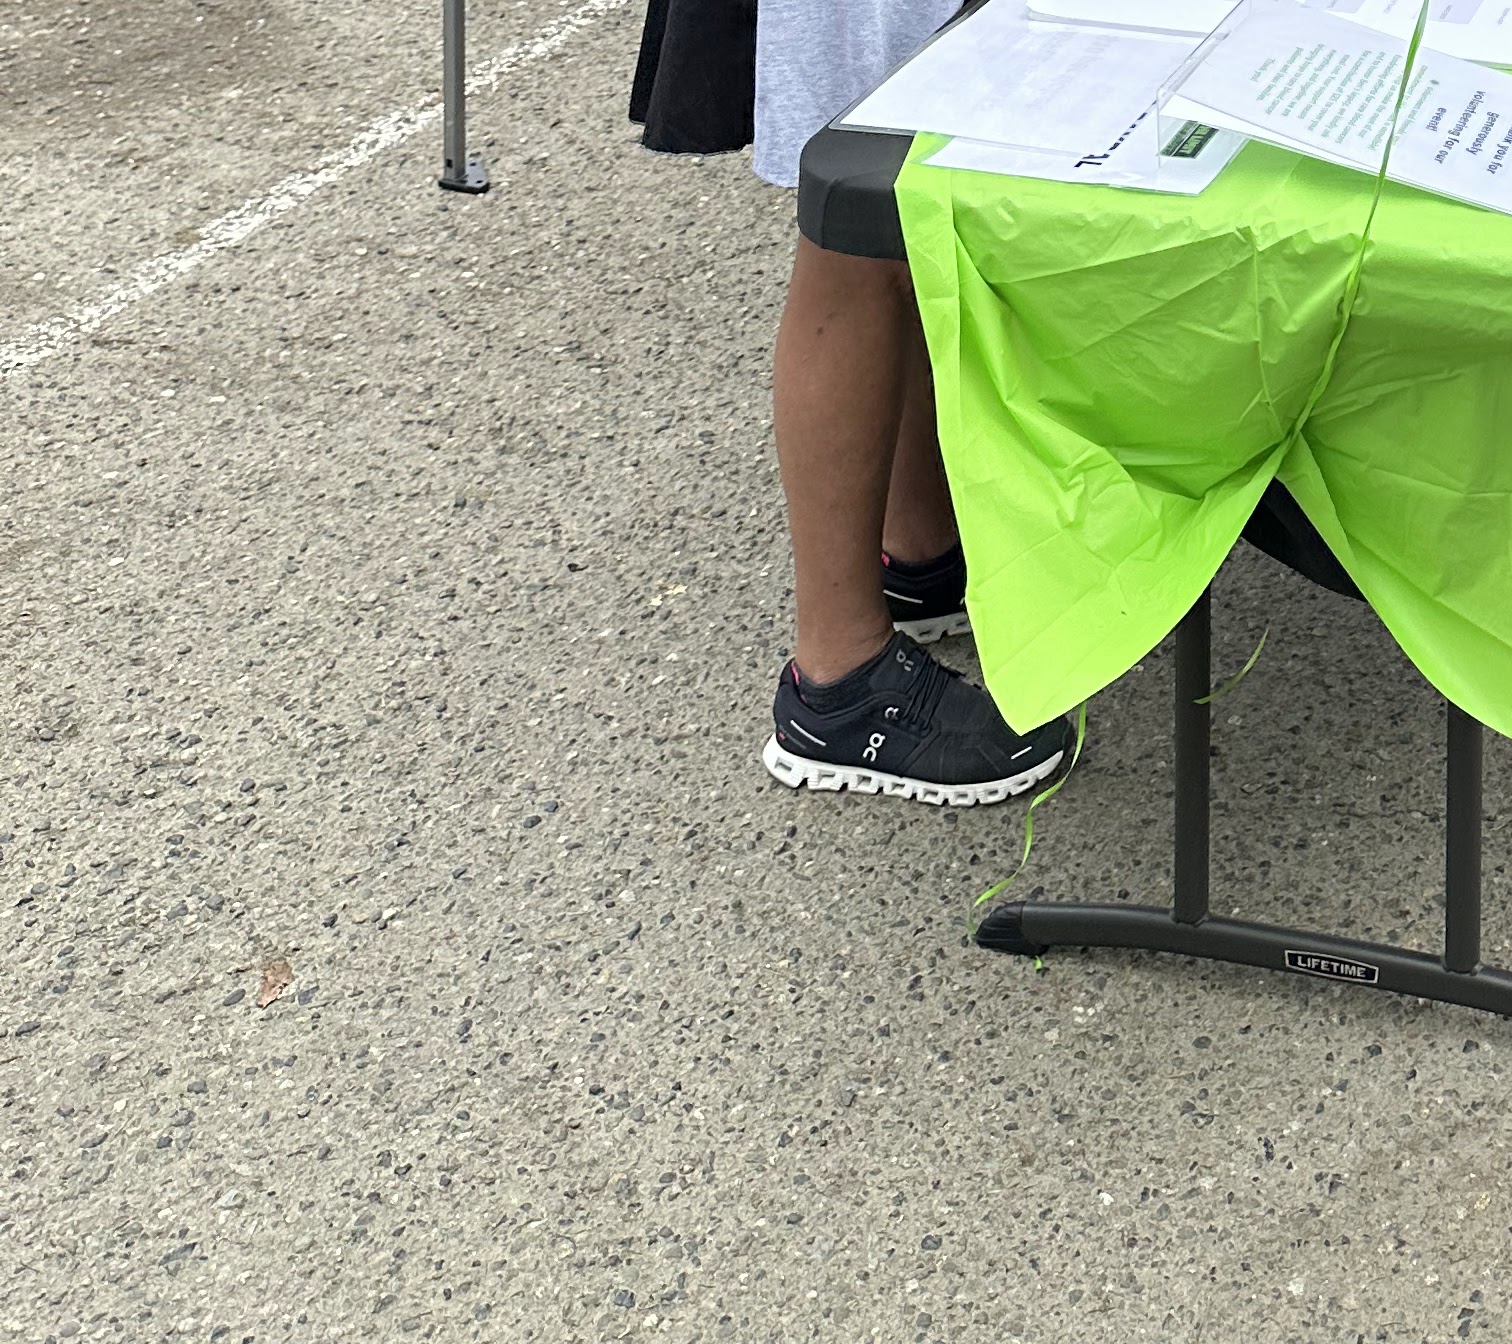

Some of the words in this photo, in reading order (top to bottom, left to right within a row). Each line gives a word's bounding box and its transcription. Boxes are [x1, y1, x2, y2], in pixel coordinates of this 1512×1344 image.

[1446, 88, 1489, 138] volunteering
[1464, 110, 1502, 156] generously
[1441, 136, 1460, 151] for
[1489, 142, 1510, 161] you
[1432, 148, 1449, 164] our
[1485, 160, 1503, 175] for
[1297, 955, 1367, 978] LIFETIME
